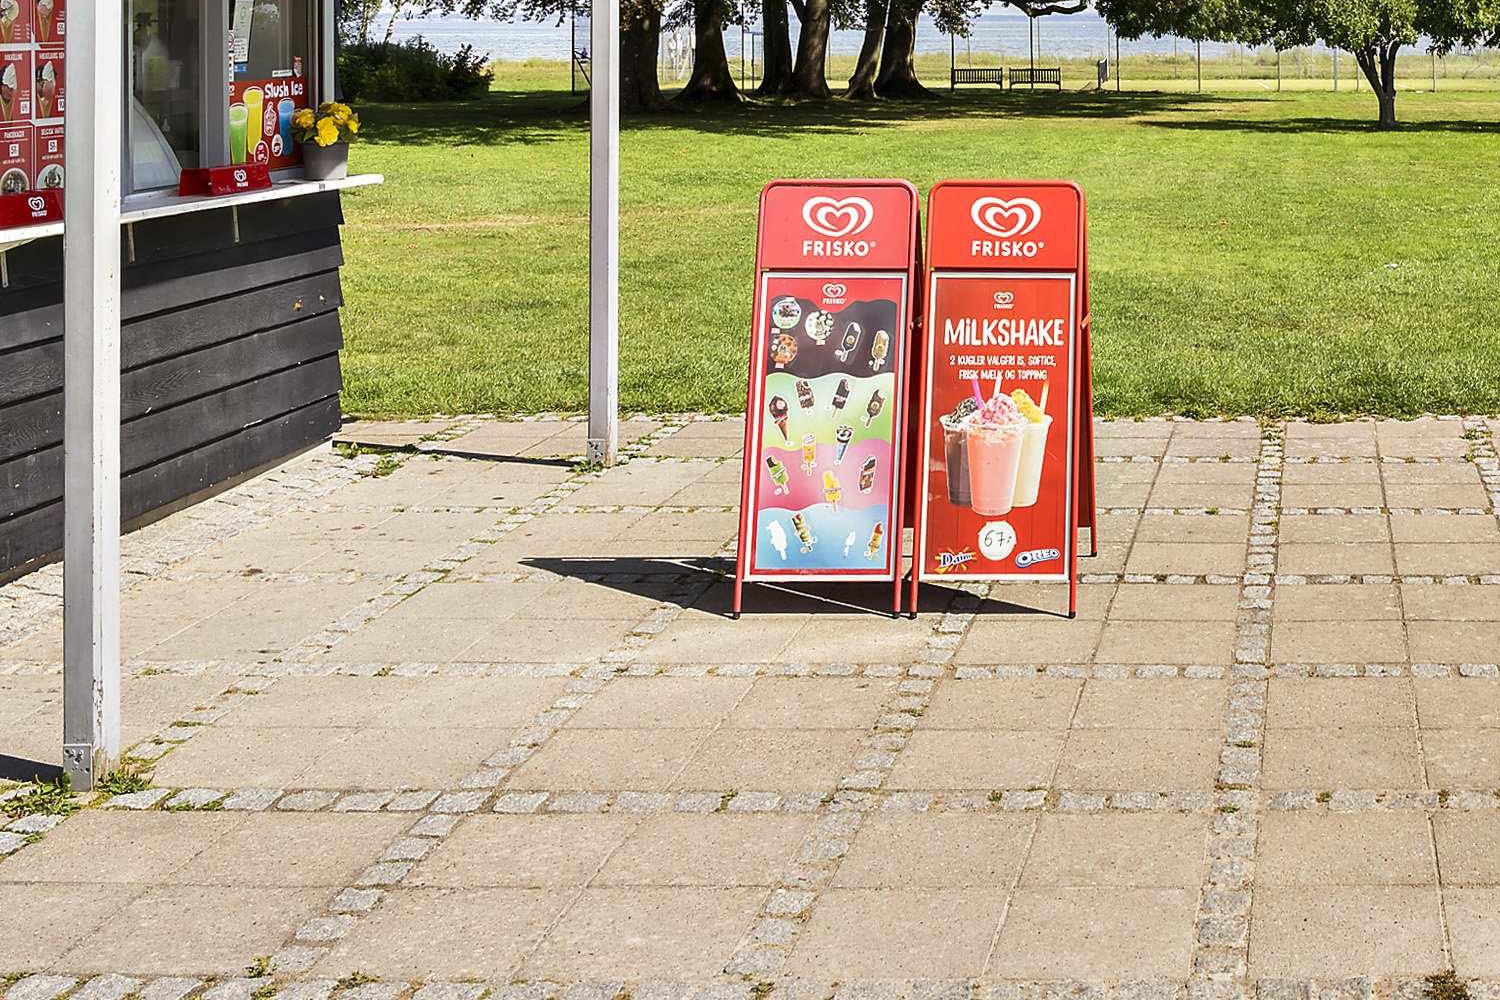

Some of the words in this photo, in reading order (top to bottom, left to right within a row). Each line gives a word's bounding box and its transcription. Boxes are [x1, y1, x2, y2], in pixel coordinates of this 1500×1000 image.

[264, 80, 289, 99] Slush
[291, 80, 303, 96] Ice
[949, 355, 956, 366] 2
[957, 355, 986, 366] KUGLER
[1005, 369, 1016, 380] OG
[1017, 369, 1048, 380] TOPPING
[941, 553, 972, 567] Daim
